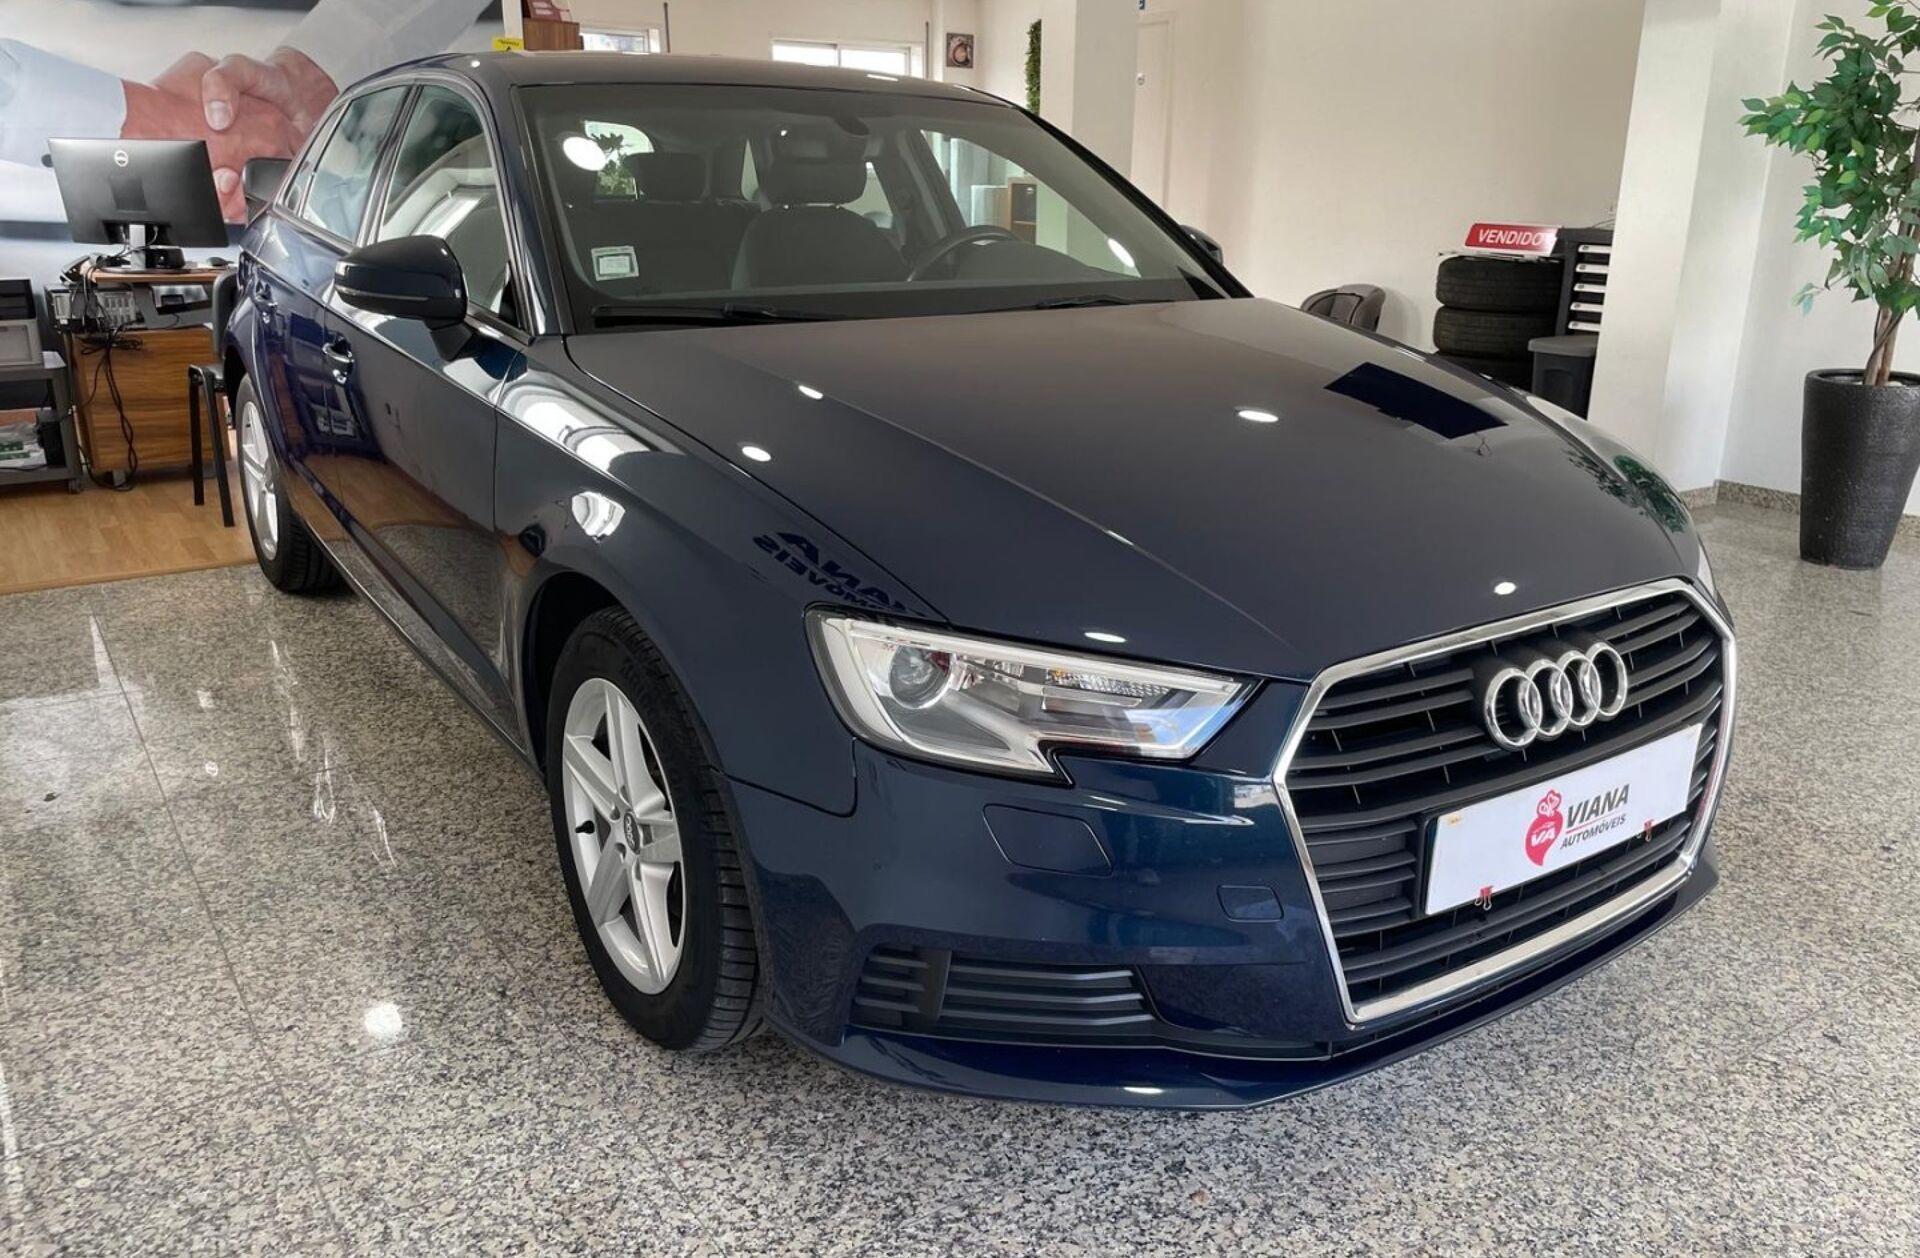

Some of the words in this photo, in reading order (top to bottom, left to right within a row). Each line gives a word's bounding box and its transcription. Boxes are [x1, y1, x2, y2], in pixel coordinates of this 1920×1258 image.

[1478, 229, 1545, 246] VENDIDO
[1566, 784, 1630, 829] VIANA
[1531, 827, 1556, 847] VA
[1560, 813, 1627, 850] AUTOMÓVEIS
